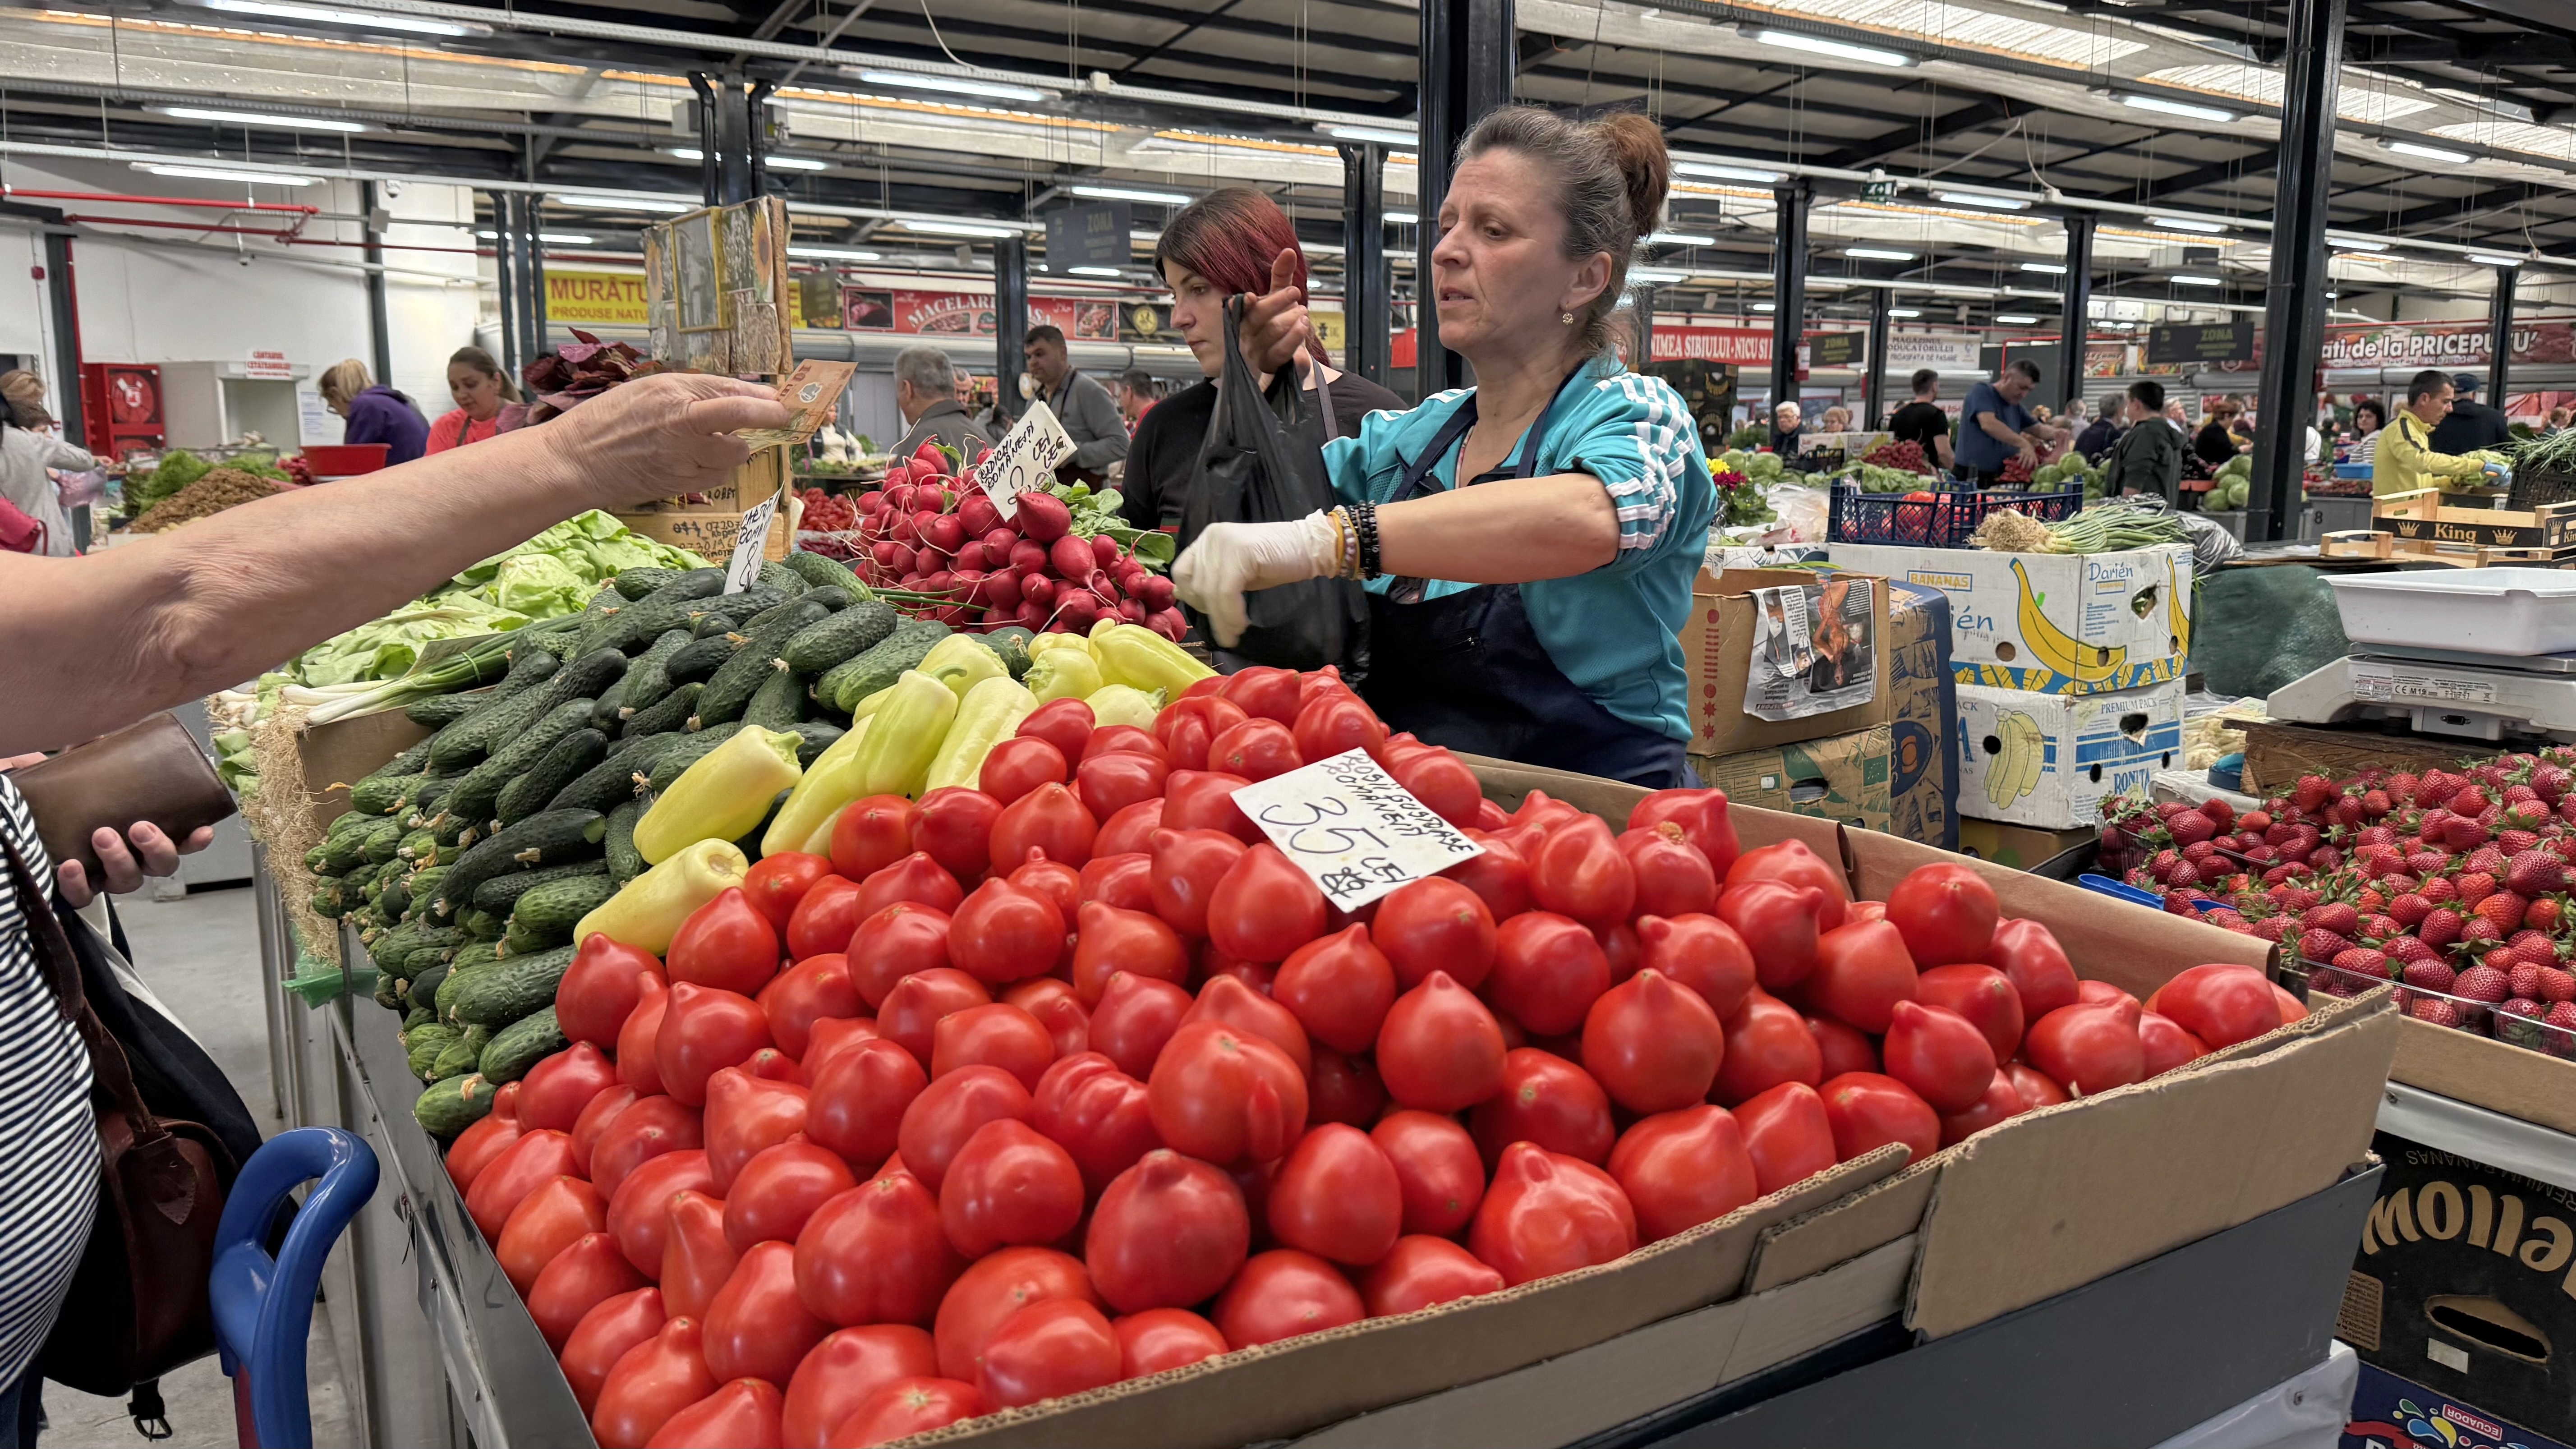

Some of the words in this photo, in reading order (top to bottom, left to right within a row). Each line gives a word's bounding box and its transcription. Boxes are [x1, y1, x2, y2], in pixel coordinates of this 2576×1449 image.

[552, 306, 612, 319] PRODUSE
[2352, 336, 2378, 358] de
[2384, 336, 2403, 357] la
[2315, 511, 2323, 524] 8
[2436, 523, 2477, 543] King
[1911, 573, 1969, 587] BANANAS
[2088, 562, 2133, 581] Darién
[2101, 699, 2138, 714] PREMIUM
[2139, 697, 2157, 709] PACK
[1260, 797, 1389, 854] 35
[2447, 1407, 2500, 1437] ECUADOR
